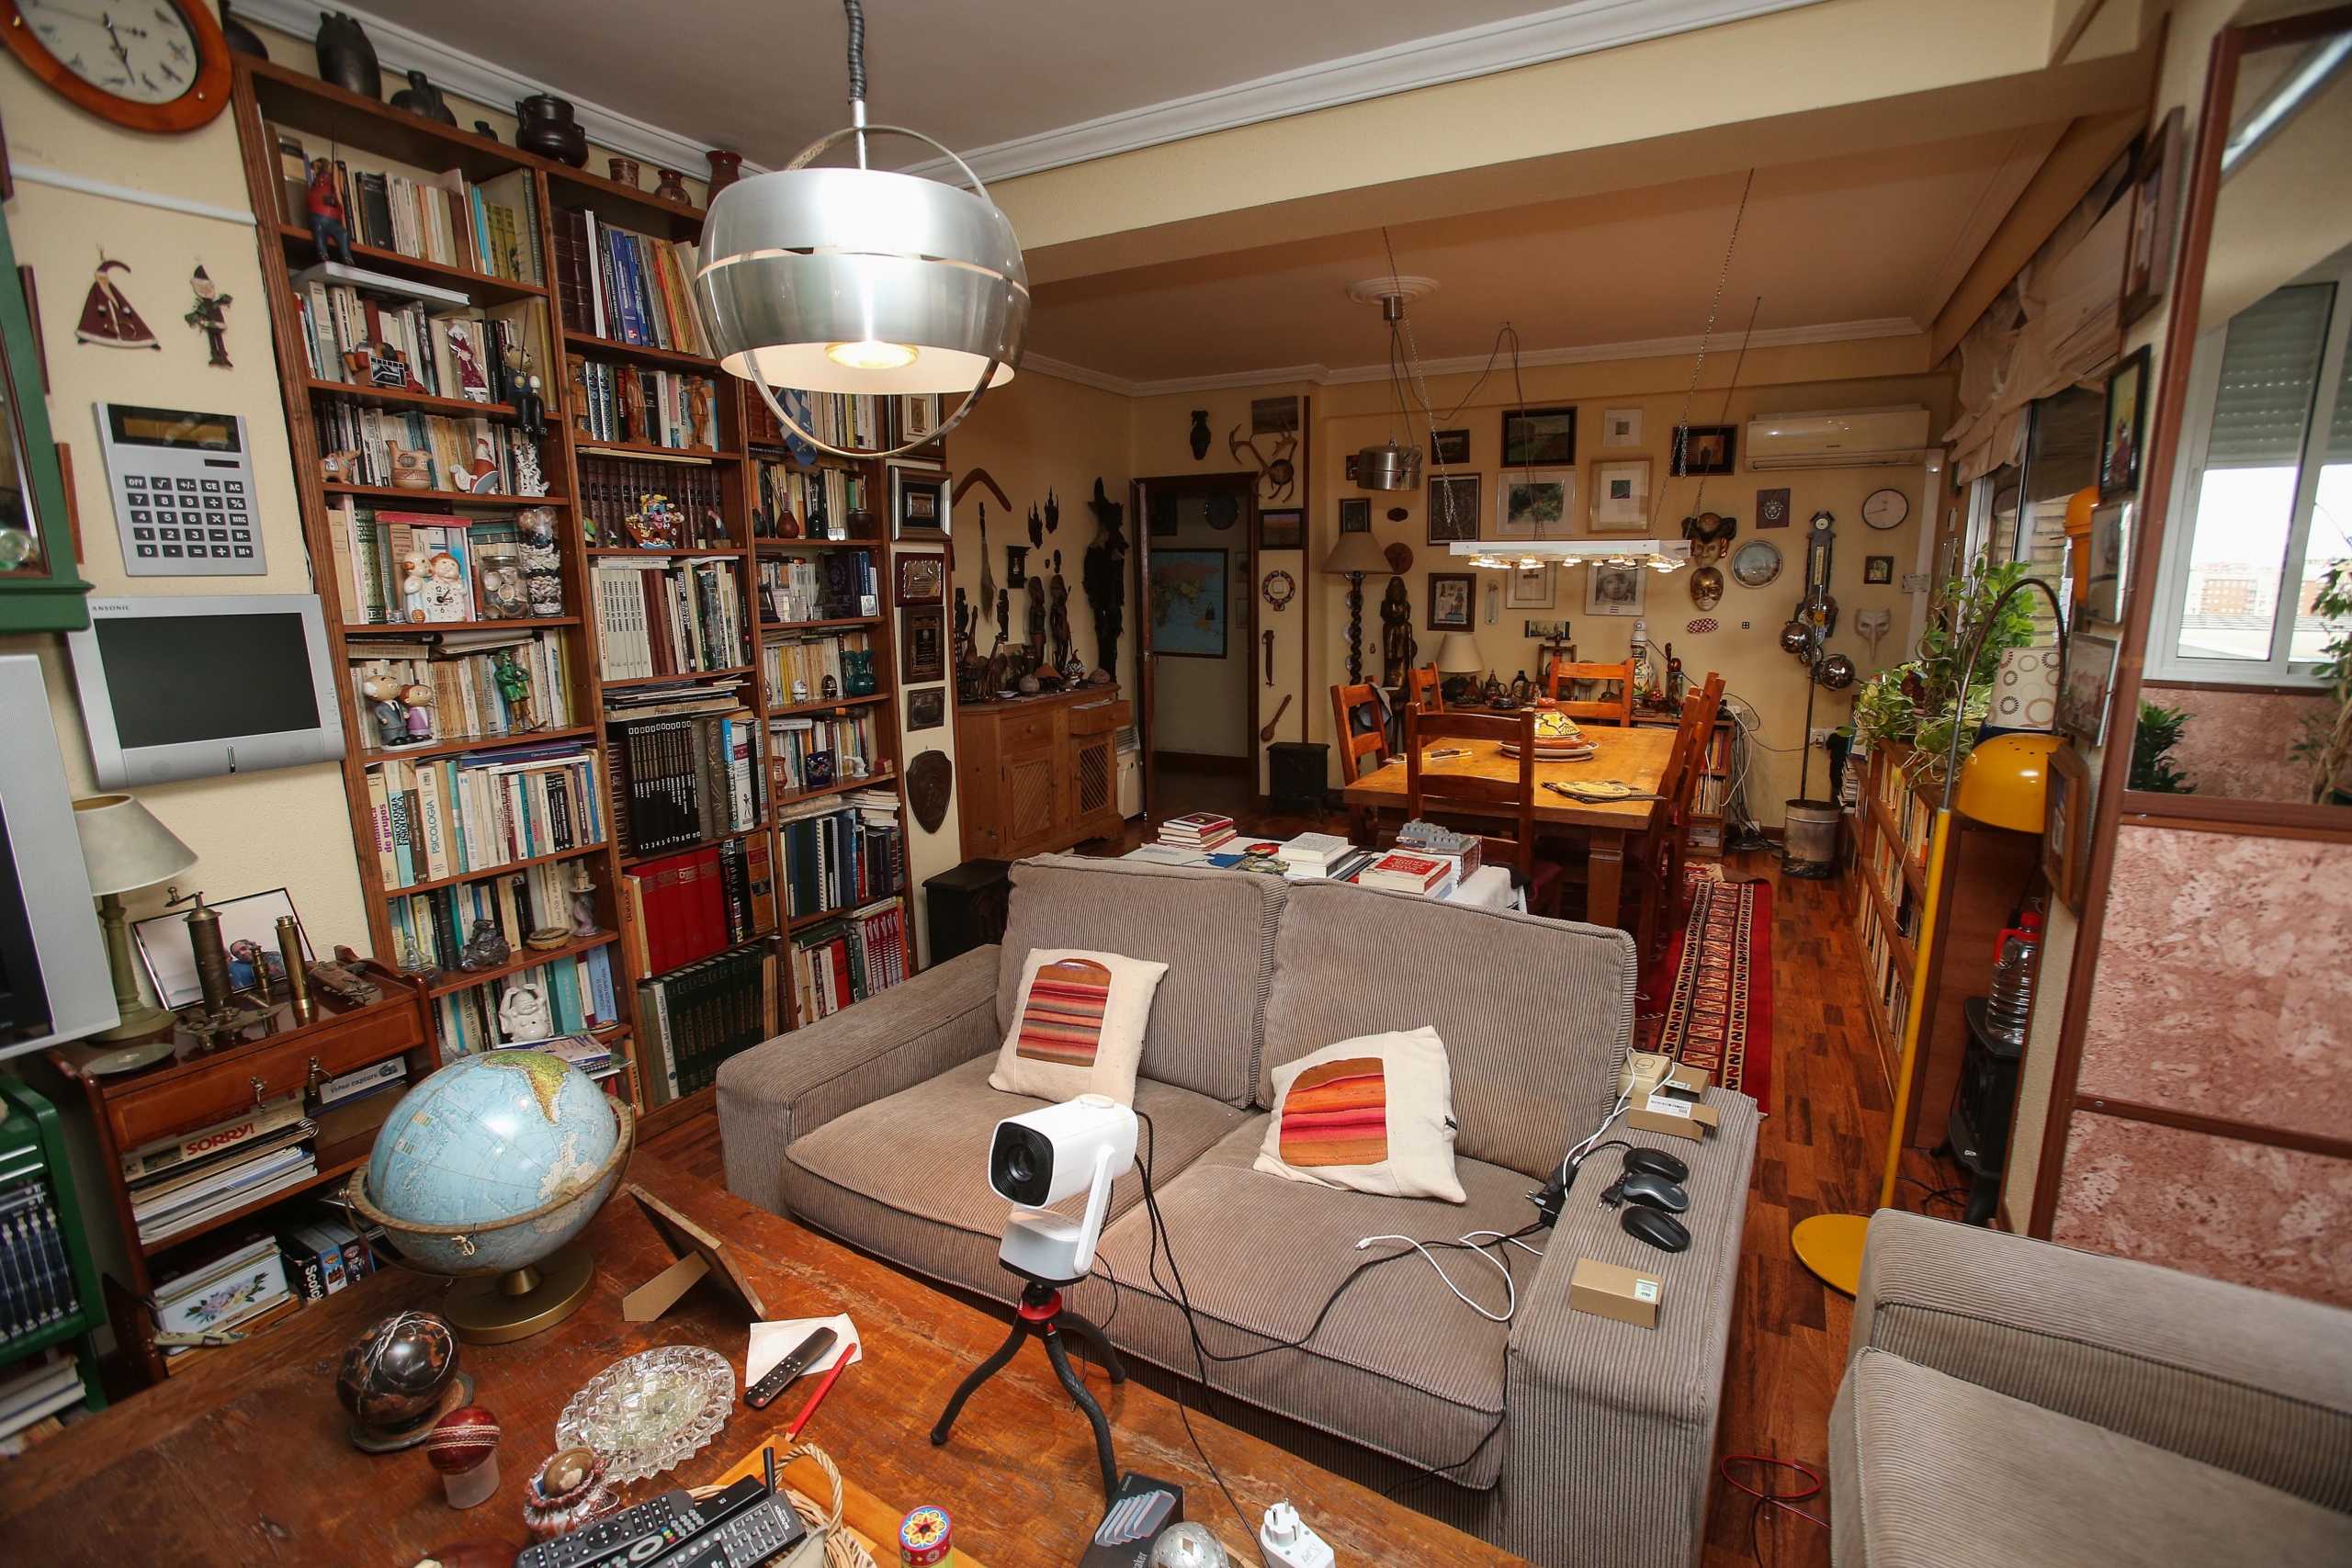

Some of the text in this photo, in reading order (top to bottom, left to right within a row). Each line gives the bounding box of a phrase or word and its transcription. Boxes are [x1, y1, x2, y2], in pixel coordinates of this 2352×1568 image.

[616, 378, 625, 397] Troya
[379, 804, 392, 852] de grupos
[390, 797, 403, 846] PSICOLOGIA
[397, 795, 409, 846] FISIOLOGICA
[426, 799, 440, 854] PSICOLOGIA
[625, 888, 633, 923] Doñana
[658, 995, 667, 1015] Aguilar
[330, 1071, 379, 1094] video capture
[187, 1122, 255, 1156] SORRY!
[775, 1505, 790, 1531] SUNSTECH
